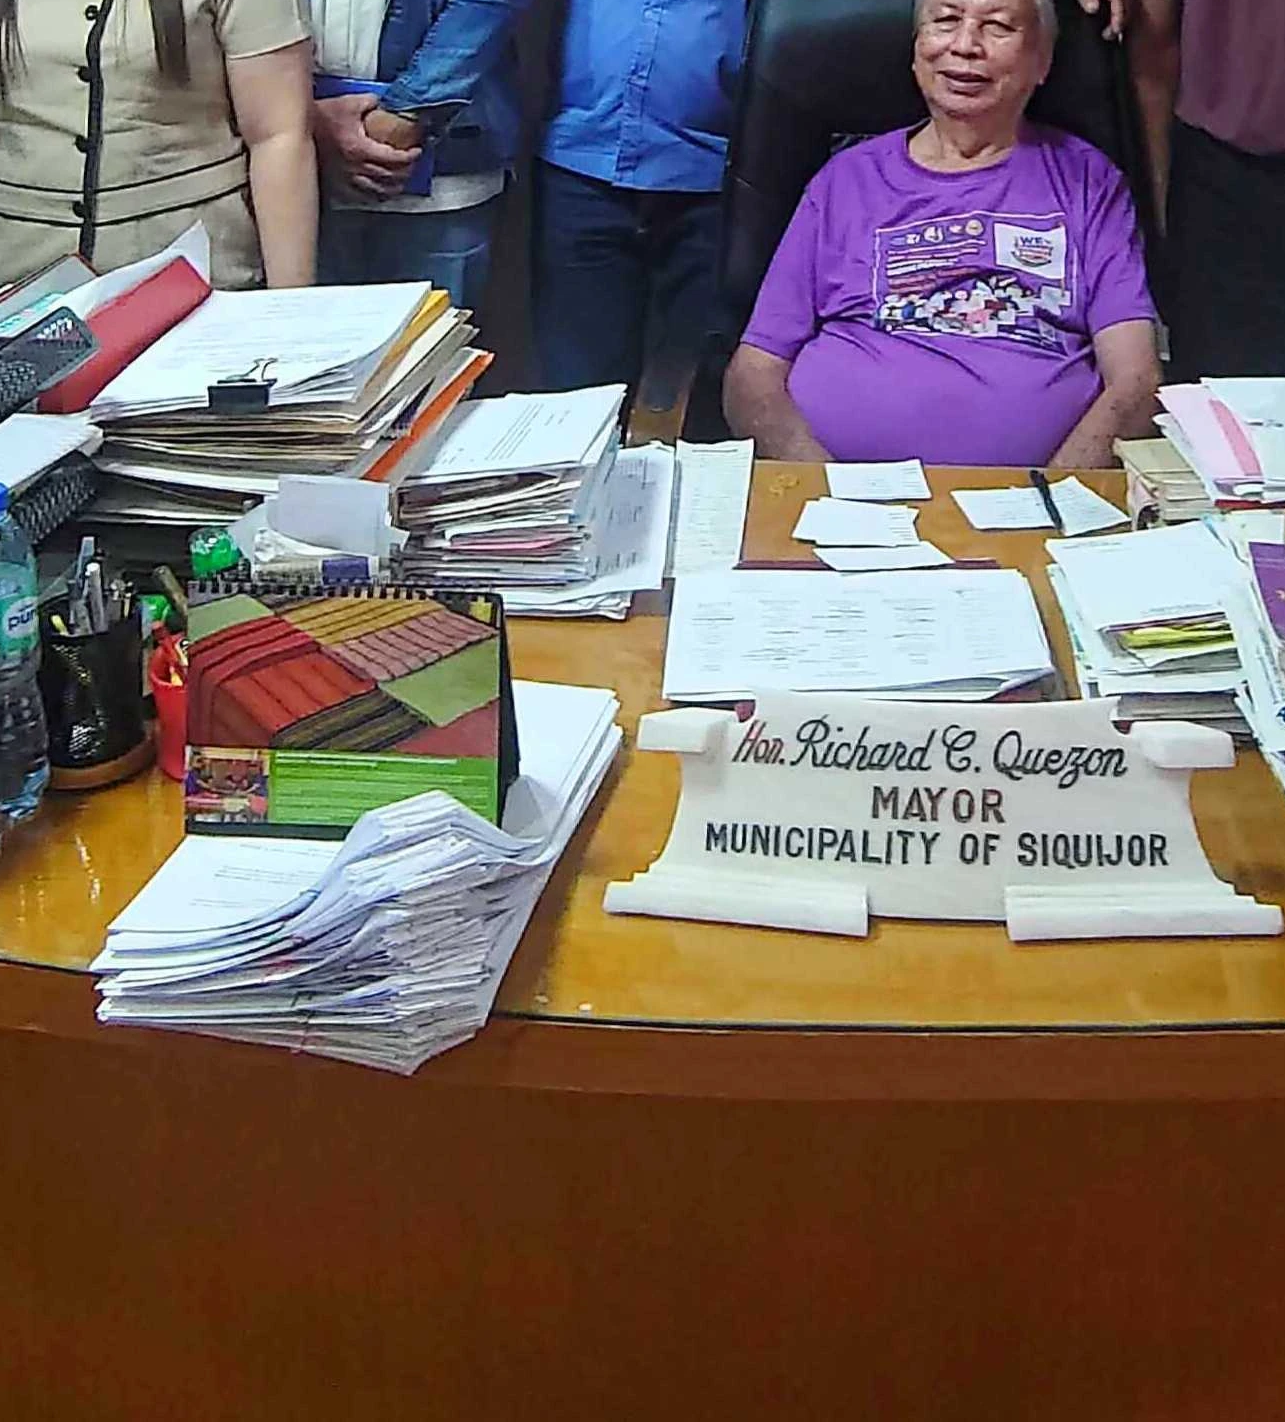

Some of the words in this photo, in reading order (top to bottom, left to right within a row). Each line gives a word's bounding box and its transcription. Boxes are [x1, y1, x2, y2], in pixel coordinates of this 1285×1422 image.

[732, 719, 786, 765] Hon.
[790, 713, 938, 772] Richard
[942, 724, 981, 773] C.
[993, 729, 1129, 790] Quezon
[872, 785, 1005, 823] MAYOR
[704, 822, 941, 866] MUNICIPALITY
[959, 833, 1001, 866] OF
[1017, 833, 1169, 869] SIQUIJOR
